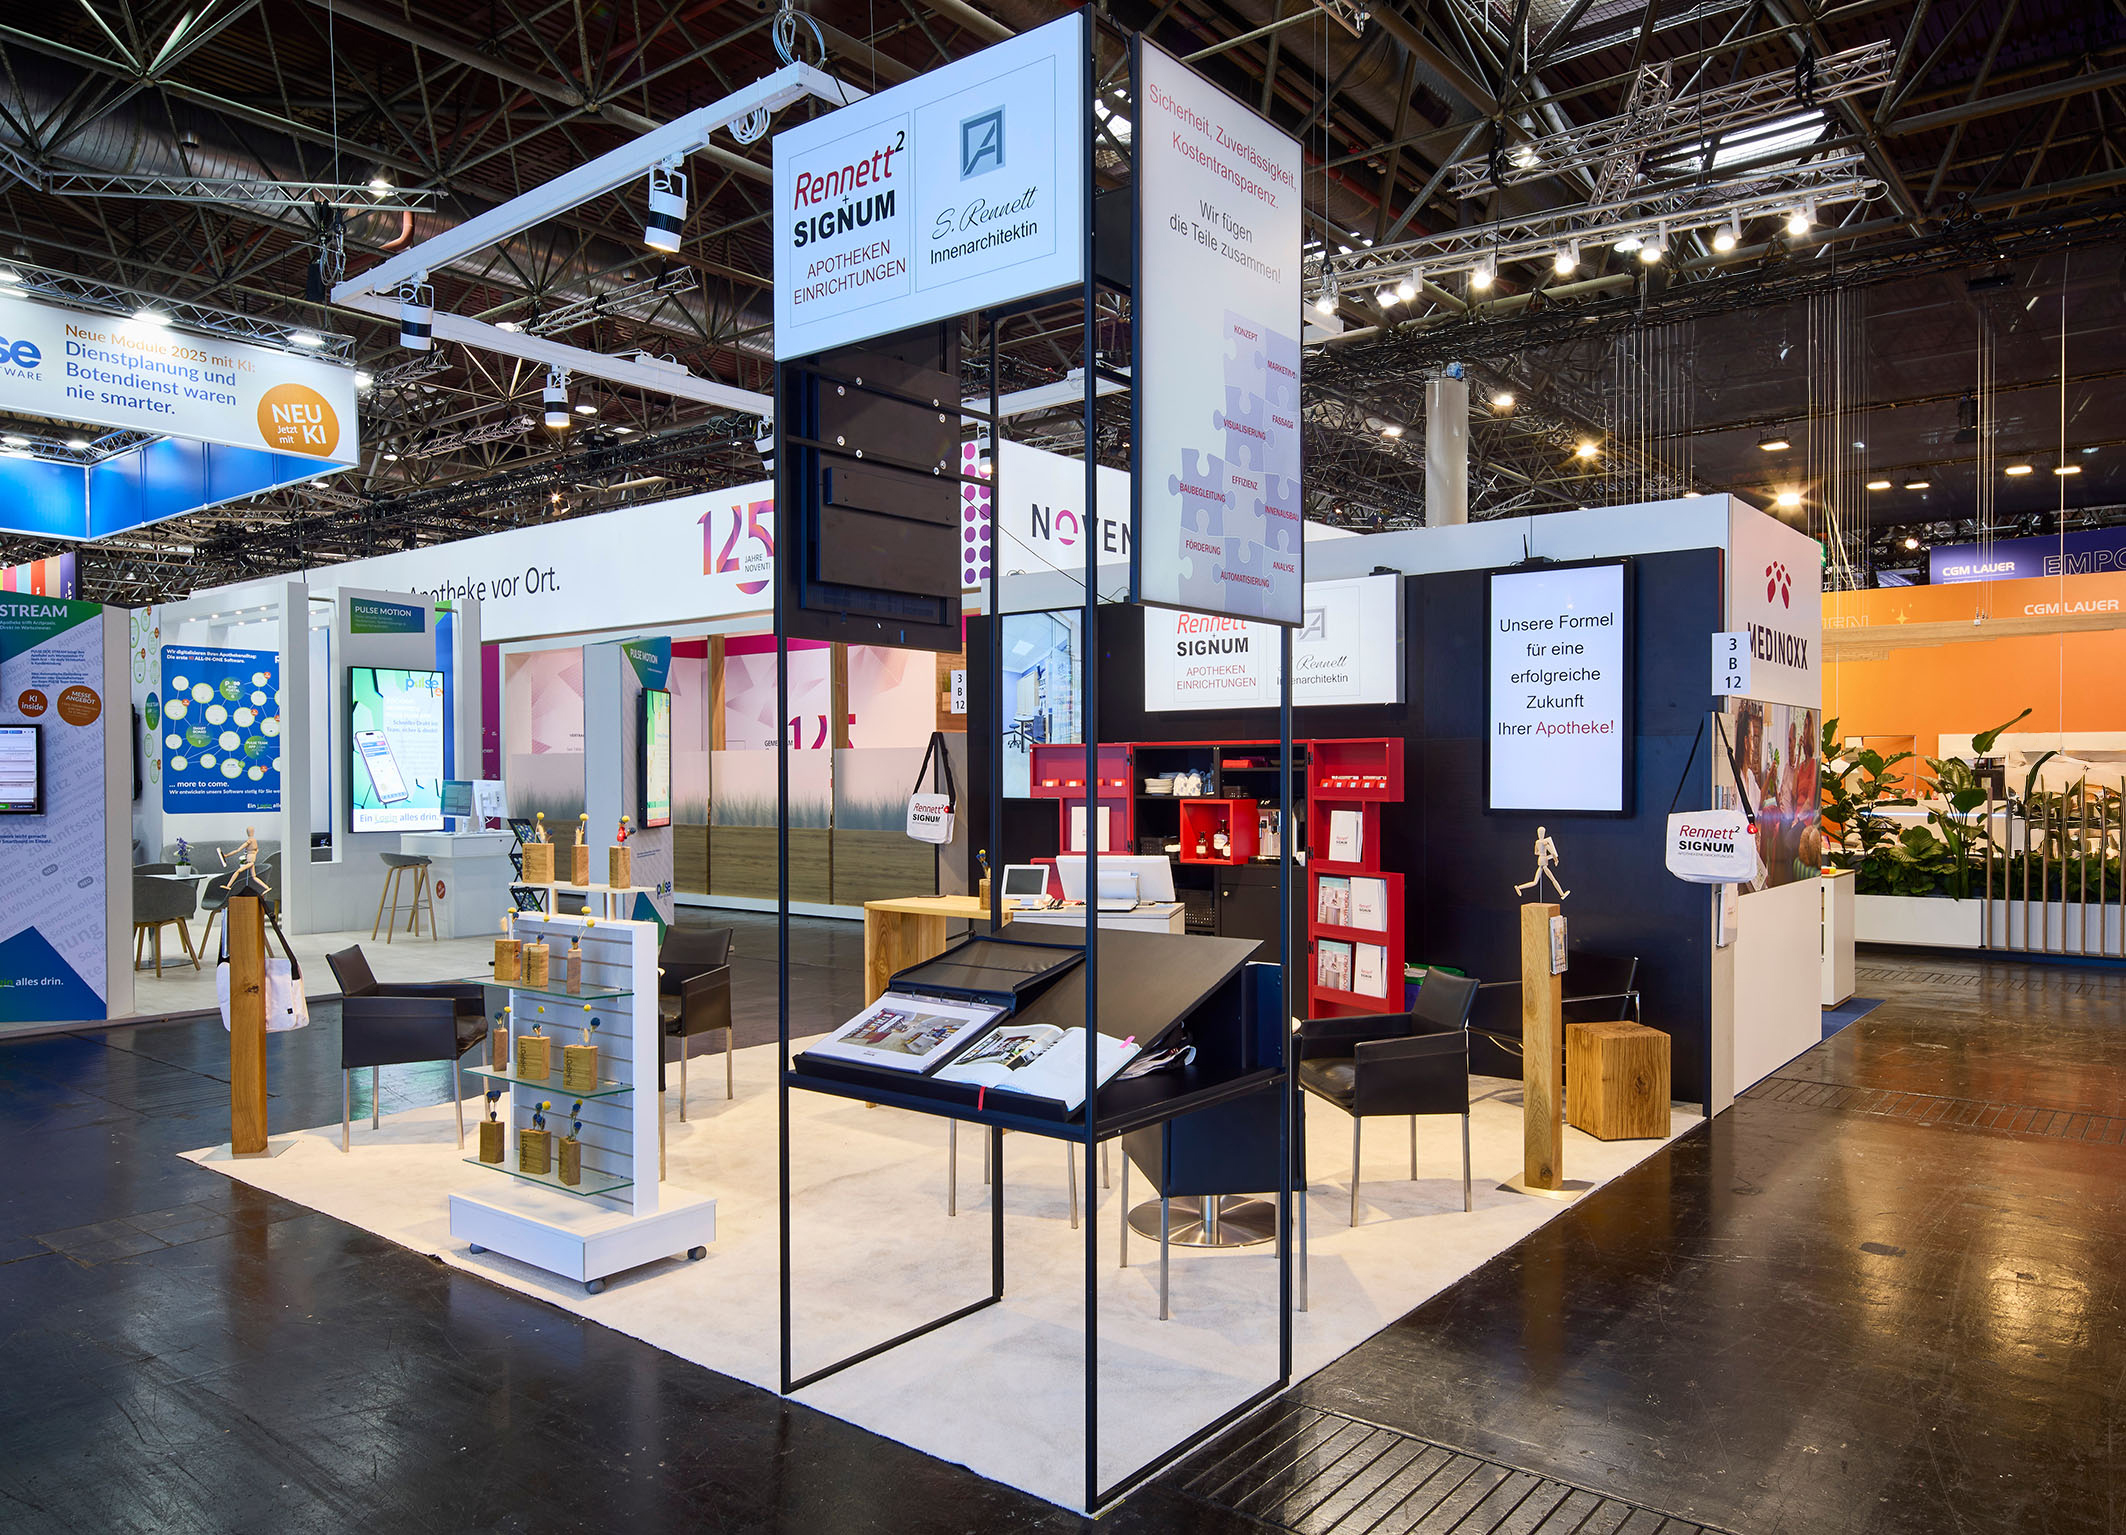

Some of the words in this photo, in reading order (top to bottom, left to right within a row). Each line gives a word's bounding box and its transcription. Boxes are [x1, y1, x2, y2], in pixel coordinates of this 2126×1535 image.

[1149, 83, 1213, 141] Sicherheit,
[1216, 125, 1297, 192] Zuverlässigkeit,
[1172, 131, 1279, 209] Kostentransparenz.
[793, 189, 896, 248] SIGNUM
[931, 208, 955, 240] S.
[959, 186, 1039, 232] Rennett
[1200, 200, 1219, 226] Wir
[1222, 213, 1253, 244] fügen
[930, 220, 1038, 265] Innenarchitektin
[1169, 213, 1188, 236] die
[1191, 222, 1217, 251] Teile
[1221, 242, 1282, 284] zusammen!
[807, 239, 891, 279] APOTHEKEN
[794, 258, 906, 305] EINRICHTUNGEN
[1233, 324, 1258, 342] KONZEPT
[65, 323, 106, 343] Neue
[111, 332, 168, 355] Module
[171, 345, 207, 363] 2025
[212, 353, 234, 369] mit
[237, 359, 256, 373] KI:
[66, 341, 199, 383] Dienstplanung
[204, 368, 236, 387] und
[0, 366, 43, 381] WARE
[67, 362, 179, 395] Botendienst
[183, 386, 237, 406] waren
[67, 383, 95, 401] nie
[100, 390, 176, 415] smarter.
[271, 403, 322, 424] NEU
[277, 424, 298, 435] Jetzt
[279, 435, 295, 445] mit
[303, 424, 327, 445] KI
[1223, 418, 1266, 440] VISUALISIERUNG
[1231, 475, 1258, 491] EFFIZIENZ
[1179, 482, 1226, 503] BAUBEGLEITUNG
[1265, 505, 1300, 522] INNENAUSBAU
[696, 499, 774, 577] 125
[1185, 539, 1221, 556] FÖRDERUNG
[745, 553, 763, 564] JAHRE
[1272, 561, 1295, 573] ANALYSE
[1942, 565, 1970, 577] CGM
[1973, 561, 2015, 574] LAUER
[491, 576, 520, 599] vor
[525, 566, 561, 595] Ort.
[1220, 570, 1270, 589] AUTOMATISIERUNG
[0, 604, 67, 618] STREAM
[355, 605, 379, 615] PULSE
[380, 608, 412, 617] MOTION
[2024, 603, 2060, 615] CGM
[2064, 599, 2119, 613] LAUER
[1499, 618, 1554, 632] Unsere
[1559, 612, 1614, 629] Formel
[1177, 637, 1249, 657] SIGNUM
[1526, 643, 1547, 657] für
[1551, 642, 1584, 656] eine
[1728, 638, 1737, 651] 3
[1747, 622, 1808, 670] MEDINOXX
[630, 648, 642, 660] PULSE
[642, 652, 658, 664] MOTION
[1728, 657, 1738, 670] B
[957, 673, 963, 683] 3
[1186, 664, 1246, 677] APOTHEKEN
[1510, 667, 1601, 685] erfolgreiche
[1176, 676, 1257, 690] EINRICHTUNGEN
[1276, 673, 1349, 686] Ienarchitektin
[1725, 676, 1742, 688] 12
[29, 694, 38, 703] KI
[65, 695, 96, 705] ANGEBOT
[72, 691, 91, 699] MESSE
[957, 687, 963, 697] B
[21, 701, 44, 711] inside
[955, 700, 965, 711] 12
[1526, 694, 1584, 709] Zukunft
[1498, 722, 1532, 736] Ihrer
[1535, 719, 1615, 738] Apotheke!
[359, 814, 373, 822] Ein
[400, 813, 418, 821] alles
[420, 813, 439, 821] drin.
[912, 814, 941, 823] SIGNUM
[1679, 840, 1734, 853] SIGNUM
[15, 977, 38, 986] alles
[40, 976, 64, 986] drin.
[519, 1041, 527, 1076] RUHRPOTT
